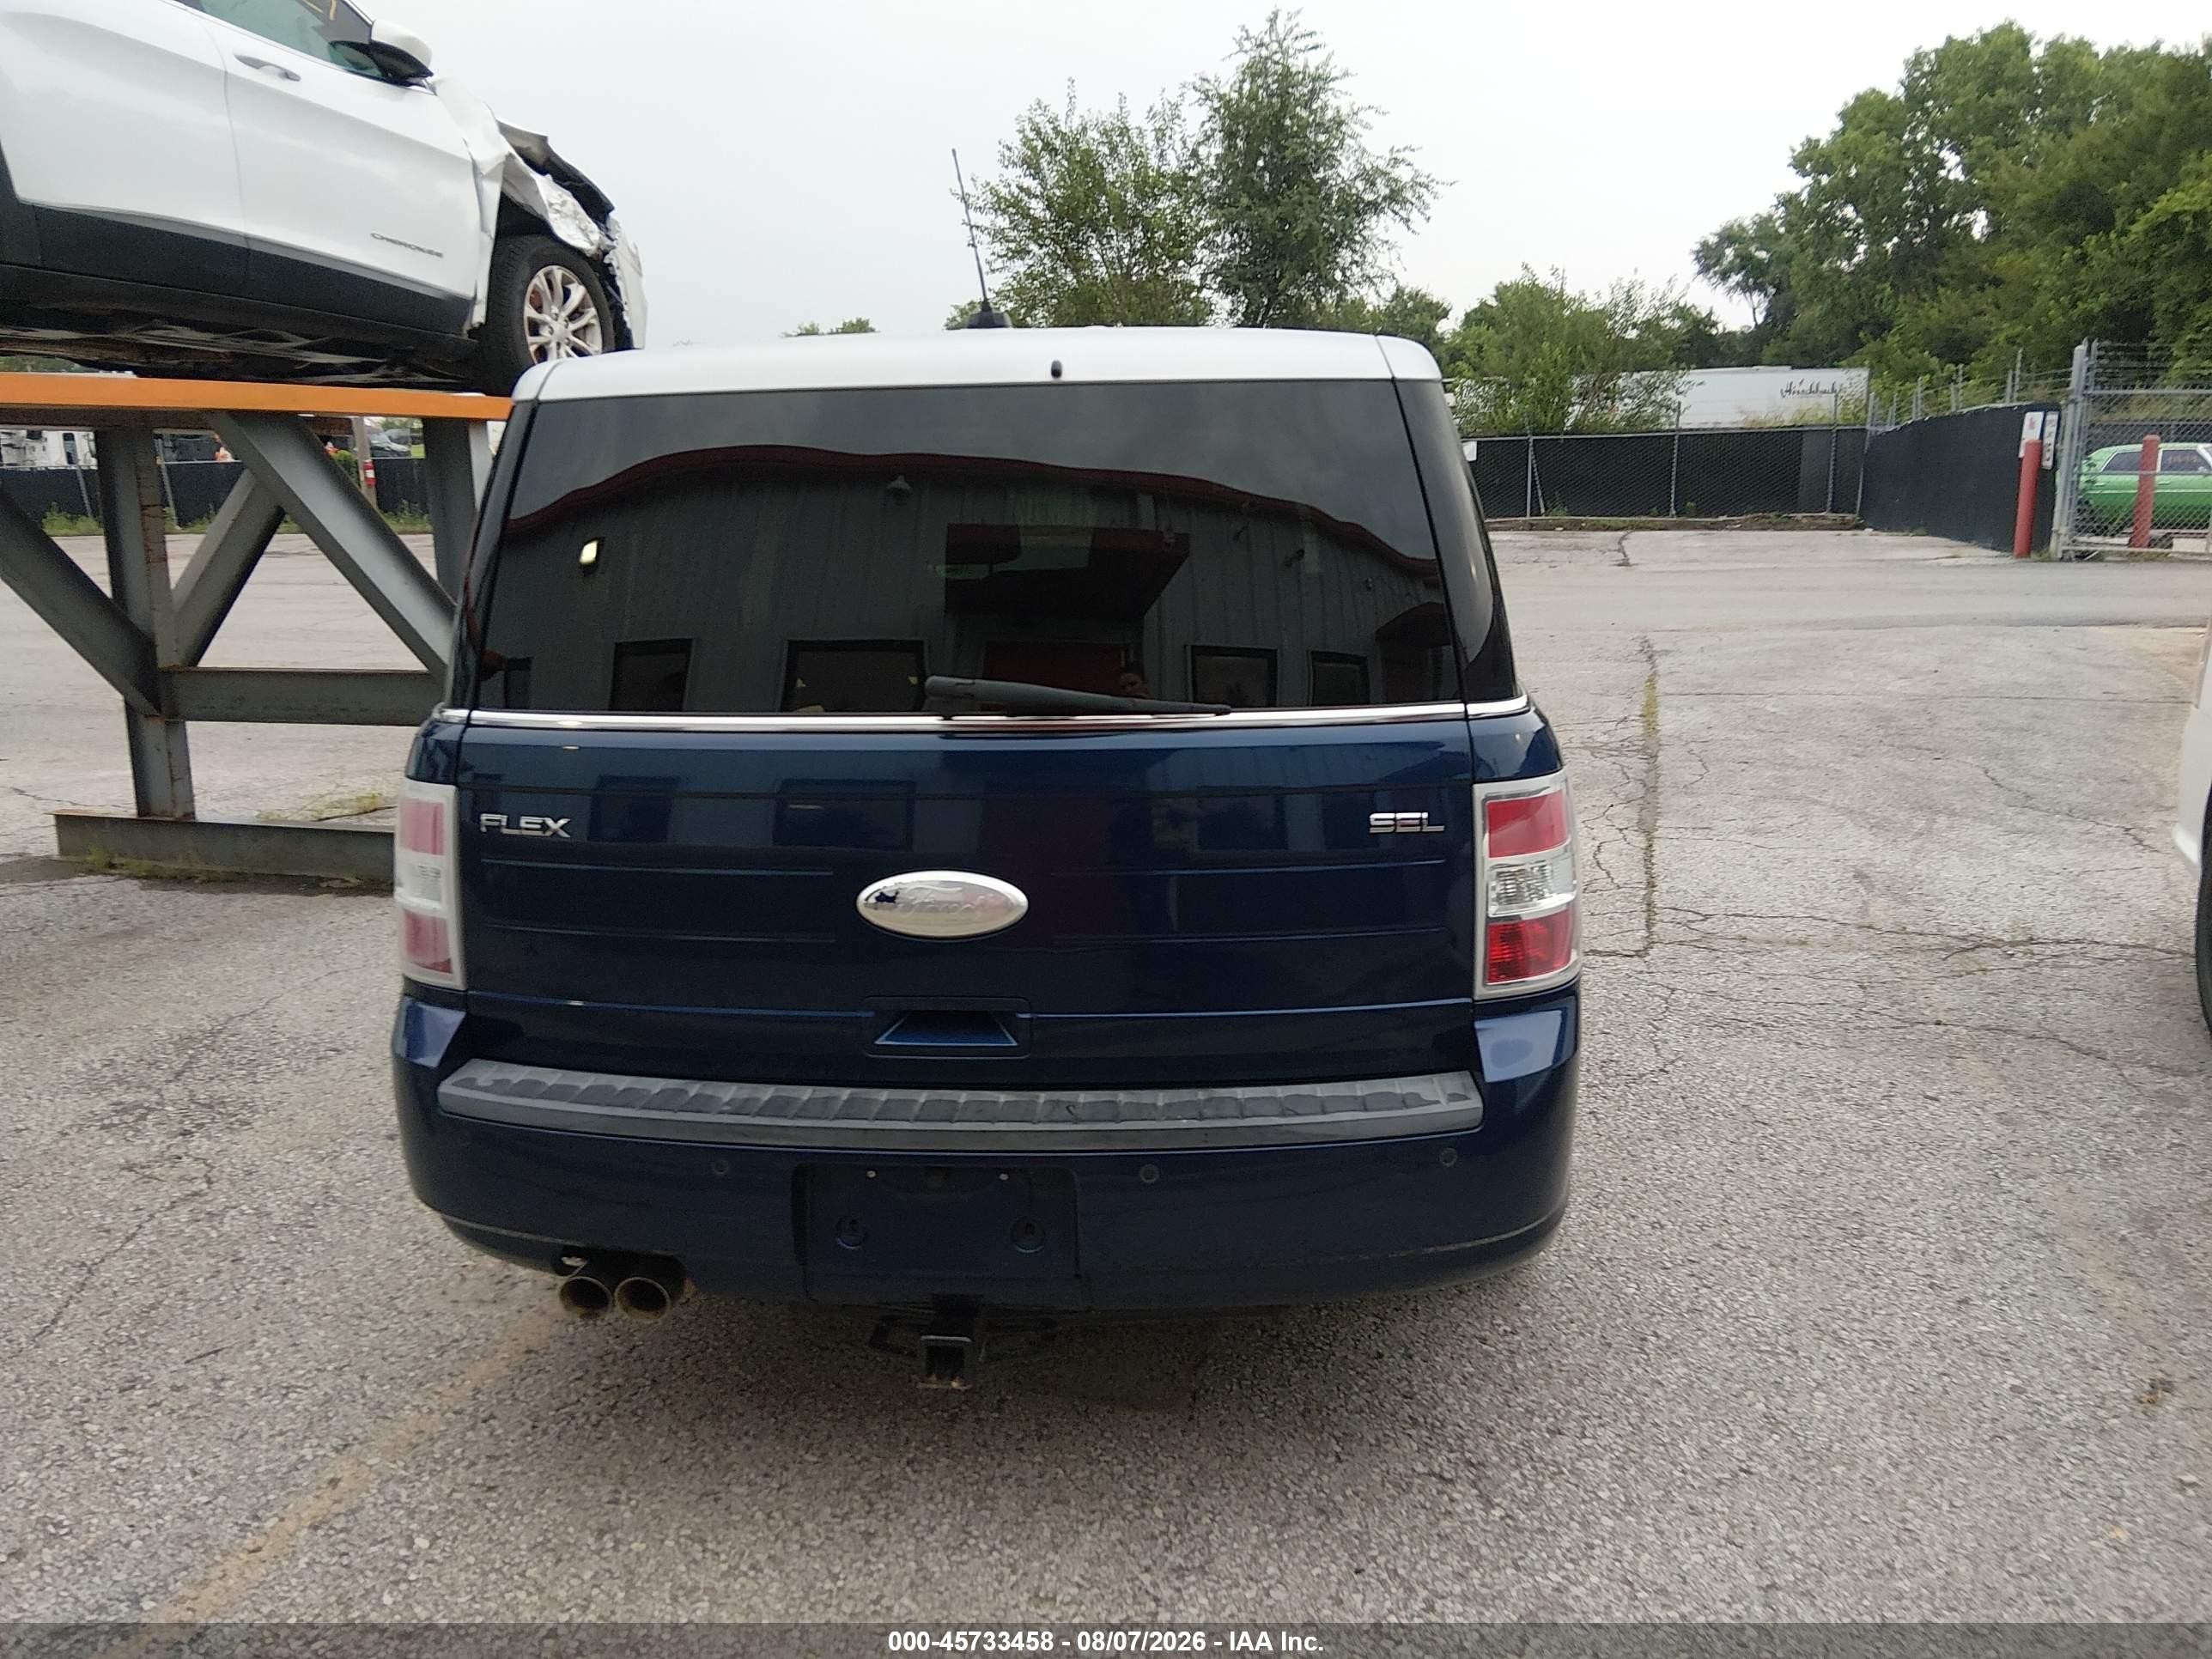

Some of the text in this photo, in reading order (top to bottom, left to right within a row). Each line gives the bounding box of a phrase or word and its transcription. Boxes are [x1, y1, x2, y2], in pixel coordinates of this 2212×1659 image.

[370, 233, 444, 258] CHEROKEE
[480, 813, 571, 838] FLEX
[1369, 811, 1445, 834] SEL
